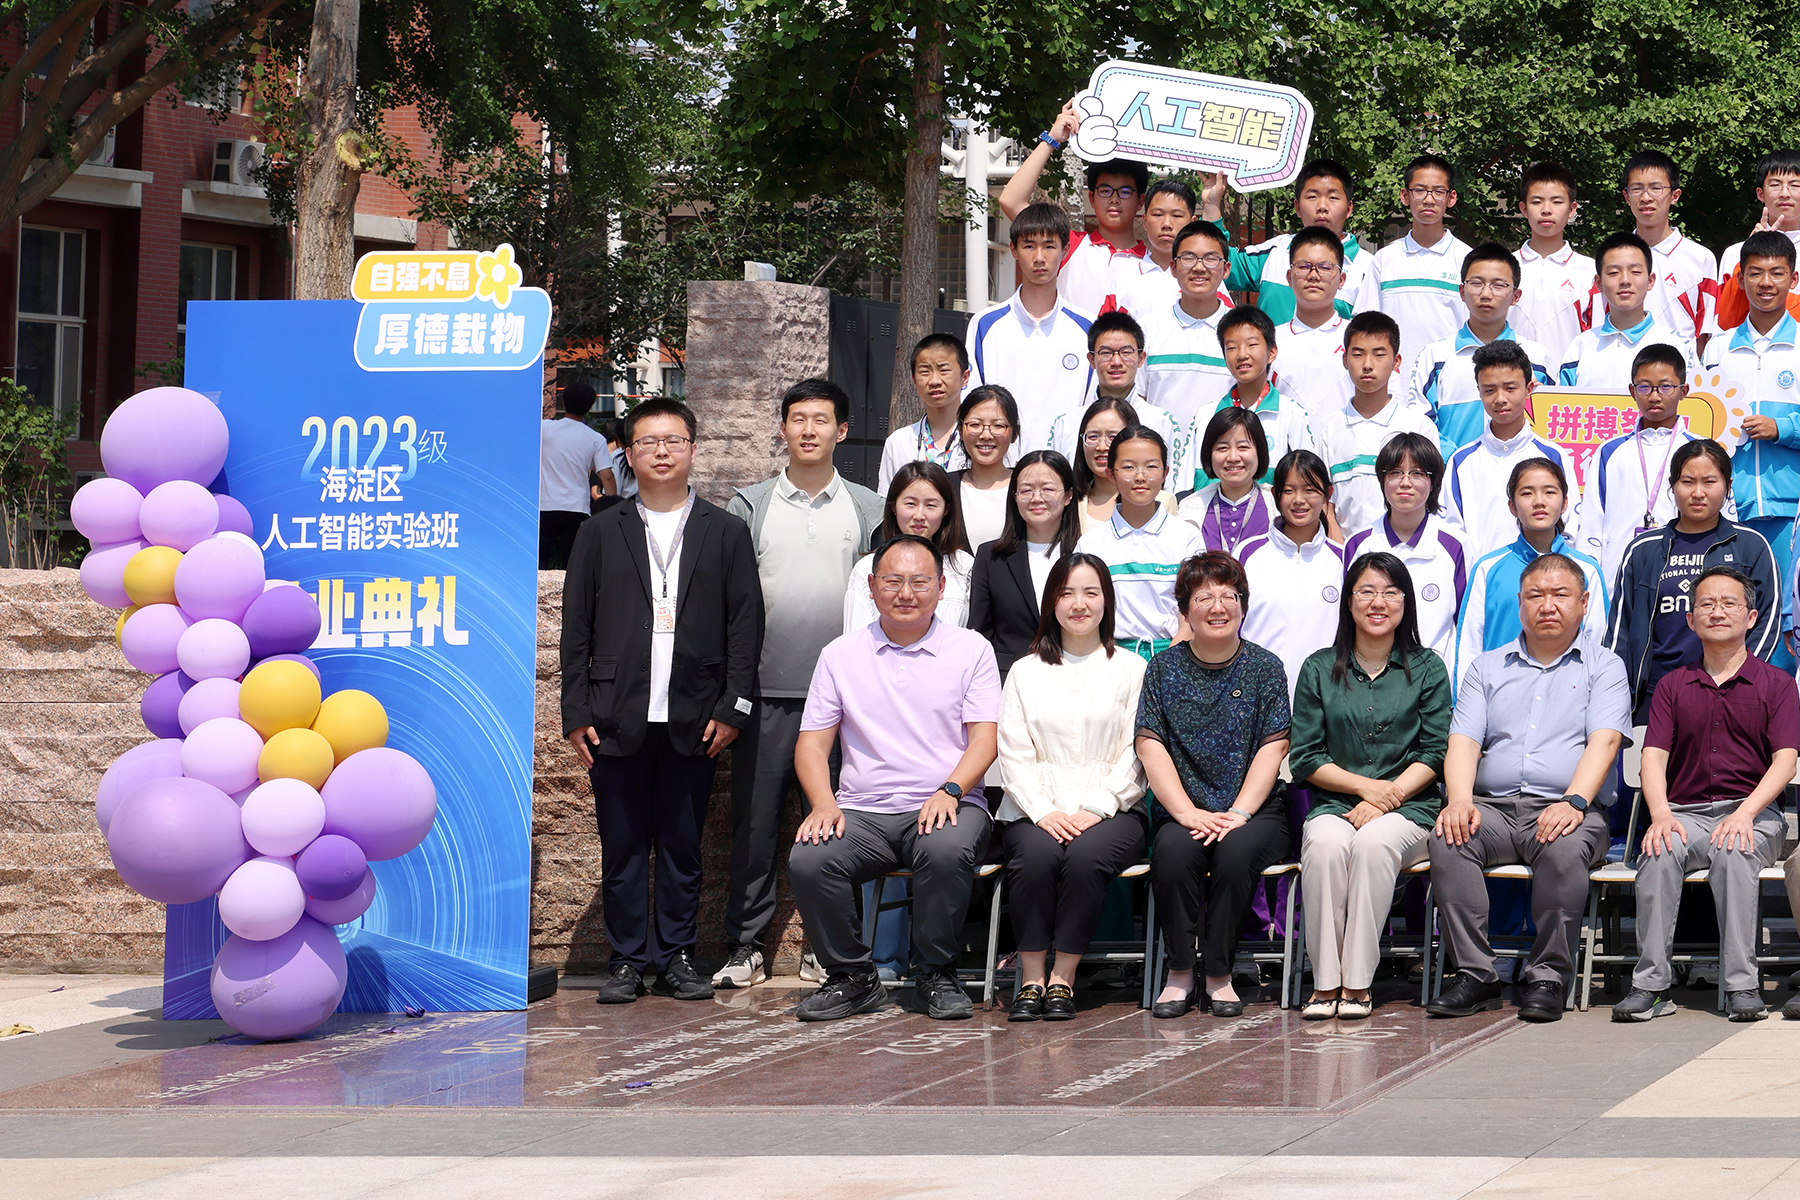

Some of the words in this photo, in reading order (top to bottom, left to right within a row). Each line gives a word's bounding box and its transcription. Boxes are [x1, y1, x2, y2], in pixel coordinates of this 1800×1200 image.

[1117, 90, 1287, 151] 人工智能
[370, 262, 470, 292] 自强不息
[374, 312, 526, 355] 厚德载物
[300, 415, 448, 482] 2023级
[319, 465, 404, 503] 海淀区
[261, 511, 459, 551] 人工智能实验班
[1659, 568, 1689, 581] TIONAL
[306, 575, 470, 650] 业典礼
